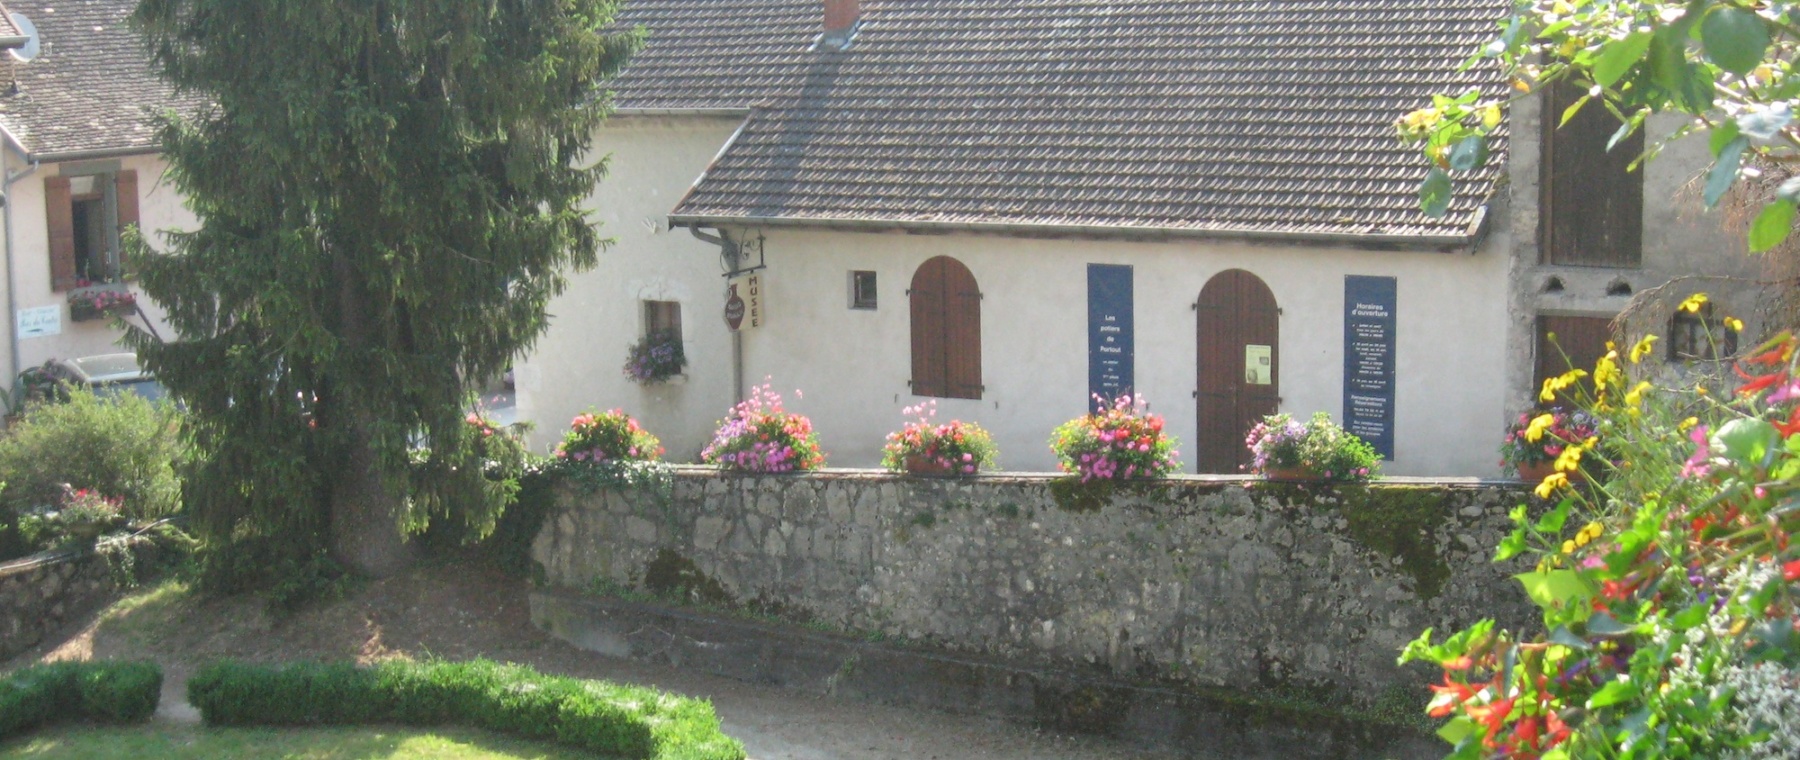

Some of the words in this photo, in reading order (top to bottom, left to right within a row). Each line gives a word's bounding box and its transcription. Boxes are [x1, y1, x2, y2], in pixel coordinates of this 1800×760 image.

[749, 276, 759, 328] MUSEE
[1356, 302, 1383, 310] Horaires
[1352, 308, 1388, 317] d'ouverture
[1100, 325, 1120, 333] potiers
